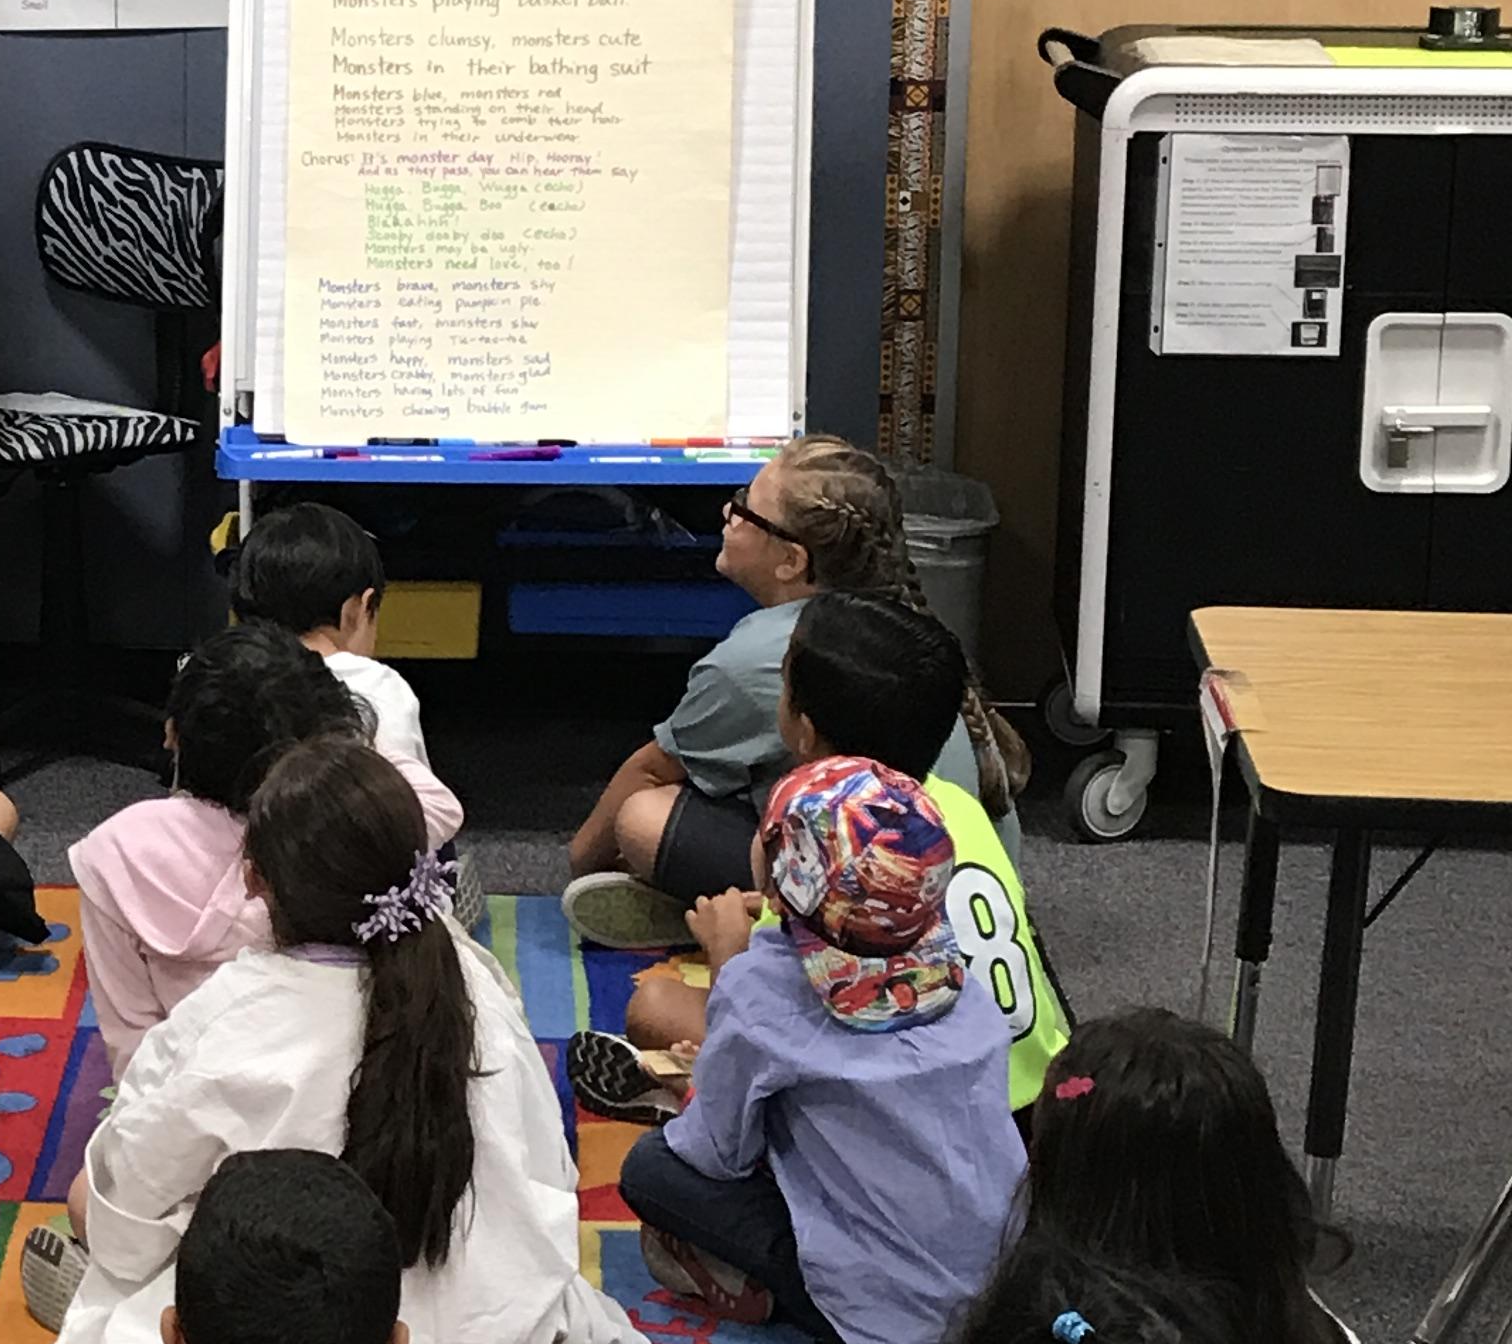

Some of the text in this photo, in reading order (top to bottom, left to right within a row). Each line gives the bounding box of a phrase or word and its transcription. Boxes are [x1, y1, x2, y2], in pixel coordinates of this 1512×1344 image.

[331, 26, 414, 48] Monsters
[512, 28, 590, 47] monsters
[598, 28, 642, 47] cute
[333, 54, 652, 84] Monsters in their bathing suit
[333, 84, 561, 101] Monsters monsters red
[335, 103, 554, 117] Monsters standing on their
[336, 116, 536, 130] Monsters trying comb
[337, 132, 480, 144] Monsters their
[361, 150, 494, 167] It's monster day
[365, 242, 425, 255] Monsters
[366, 256, 478, 272] Monsters need
[318, 277, 521, 296] Monsters monsters
[321, 296, 511, 314] Monsters eating pumpkin
[319, 316, 503, 330] Monsters monsters
[389, 333, 432, 349] playing
[448, 352, 512, 367] monsters
[324, 369, 514, 383] Monsters monsters
[945, 862, 1036, 1040] 8
